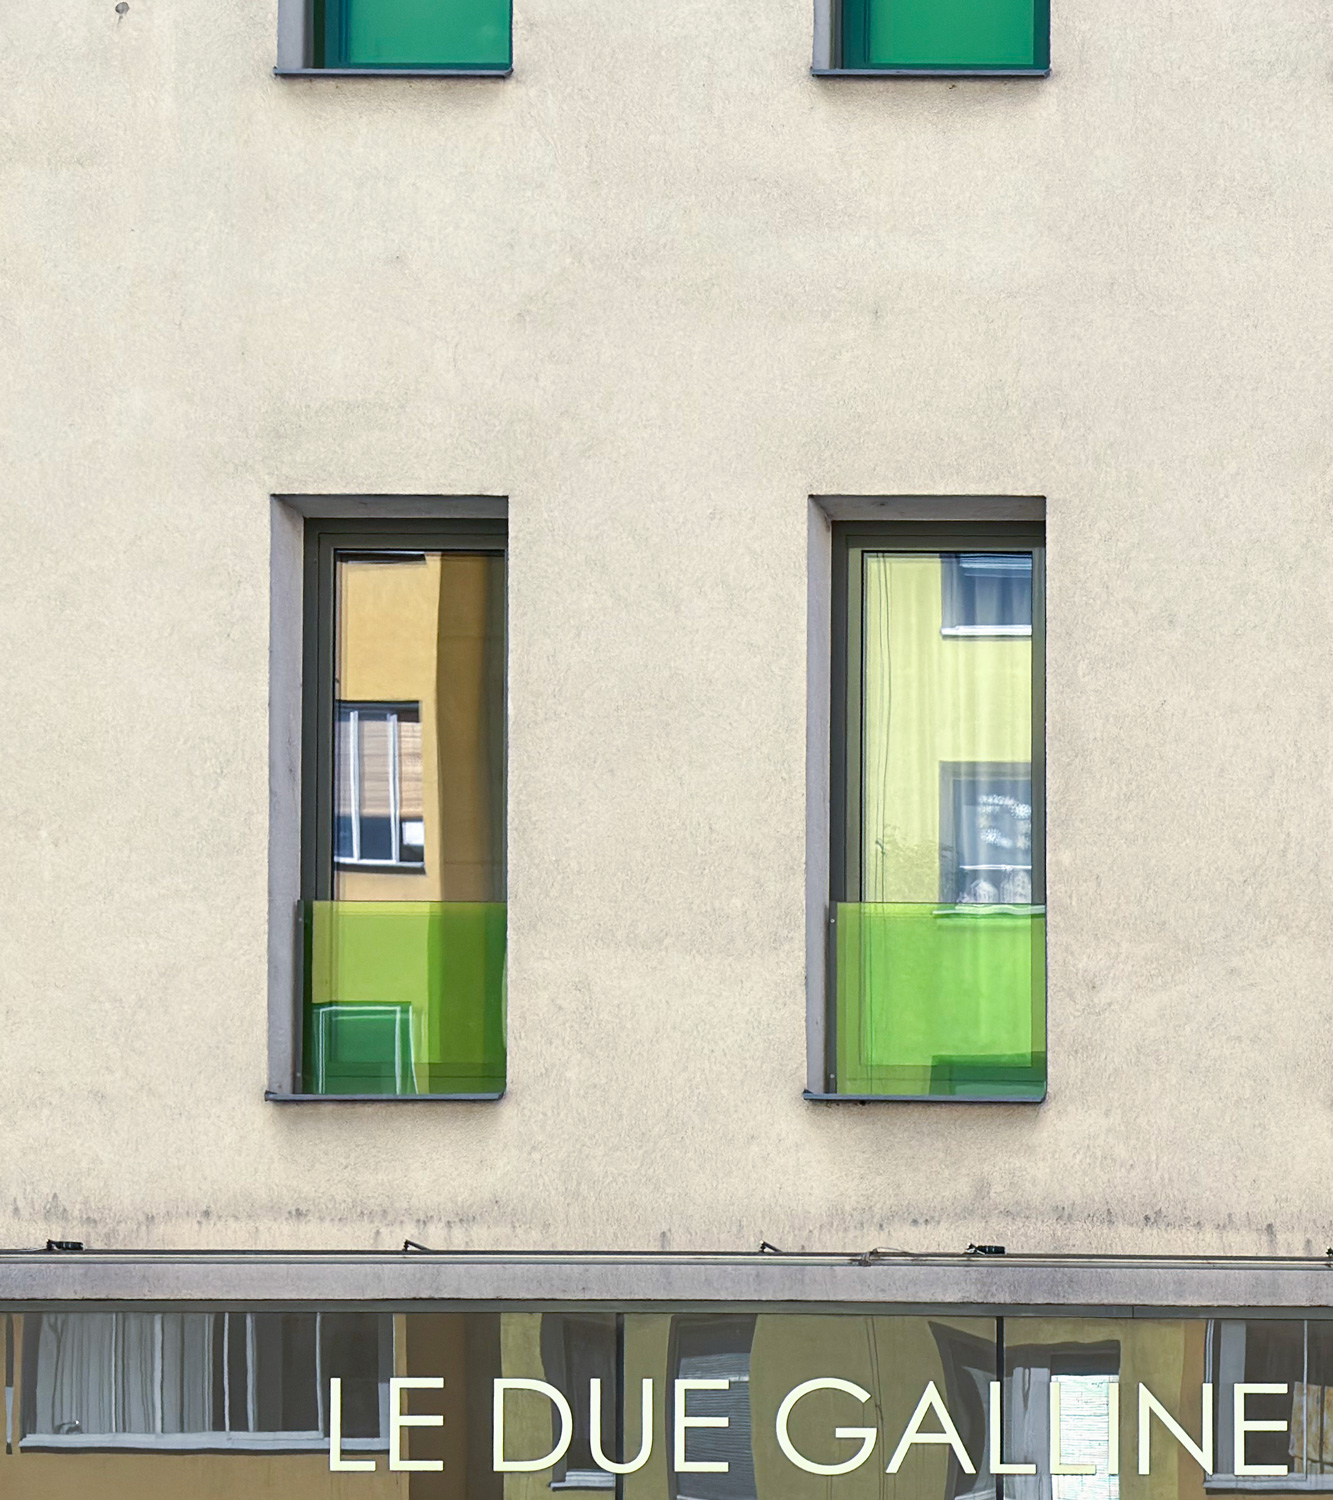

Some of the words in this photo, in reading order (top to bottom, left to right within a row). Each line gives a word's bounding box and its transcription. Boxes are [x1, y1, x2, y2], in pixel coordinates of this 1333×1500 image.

[329, 1377, 445, 1472] LE
[493, 1377, 730, 1475] DUE
[776, 1377, 1289, 1476] GALLINE
